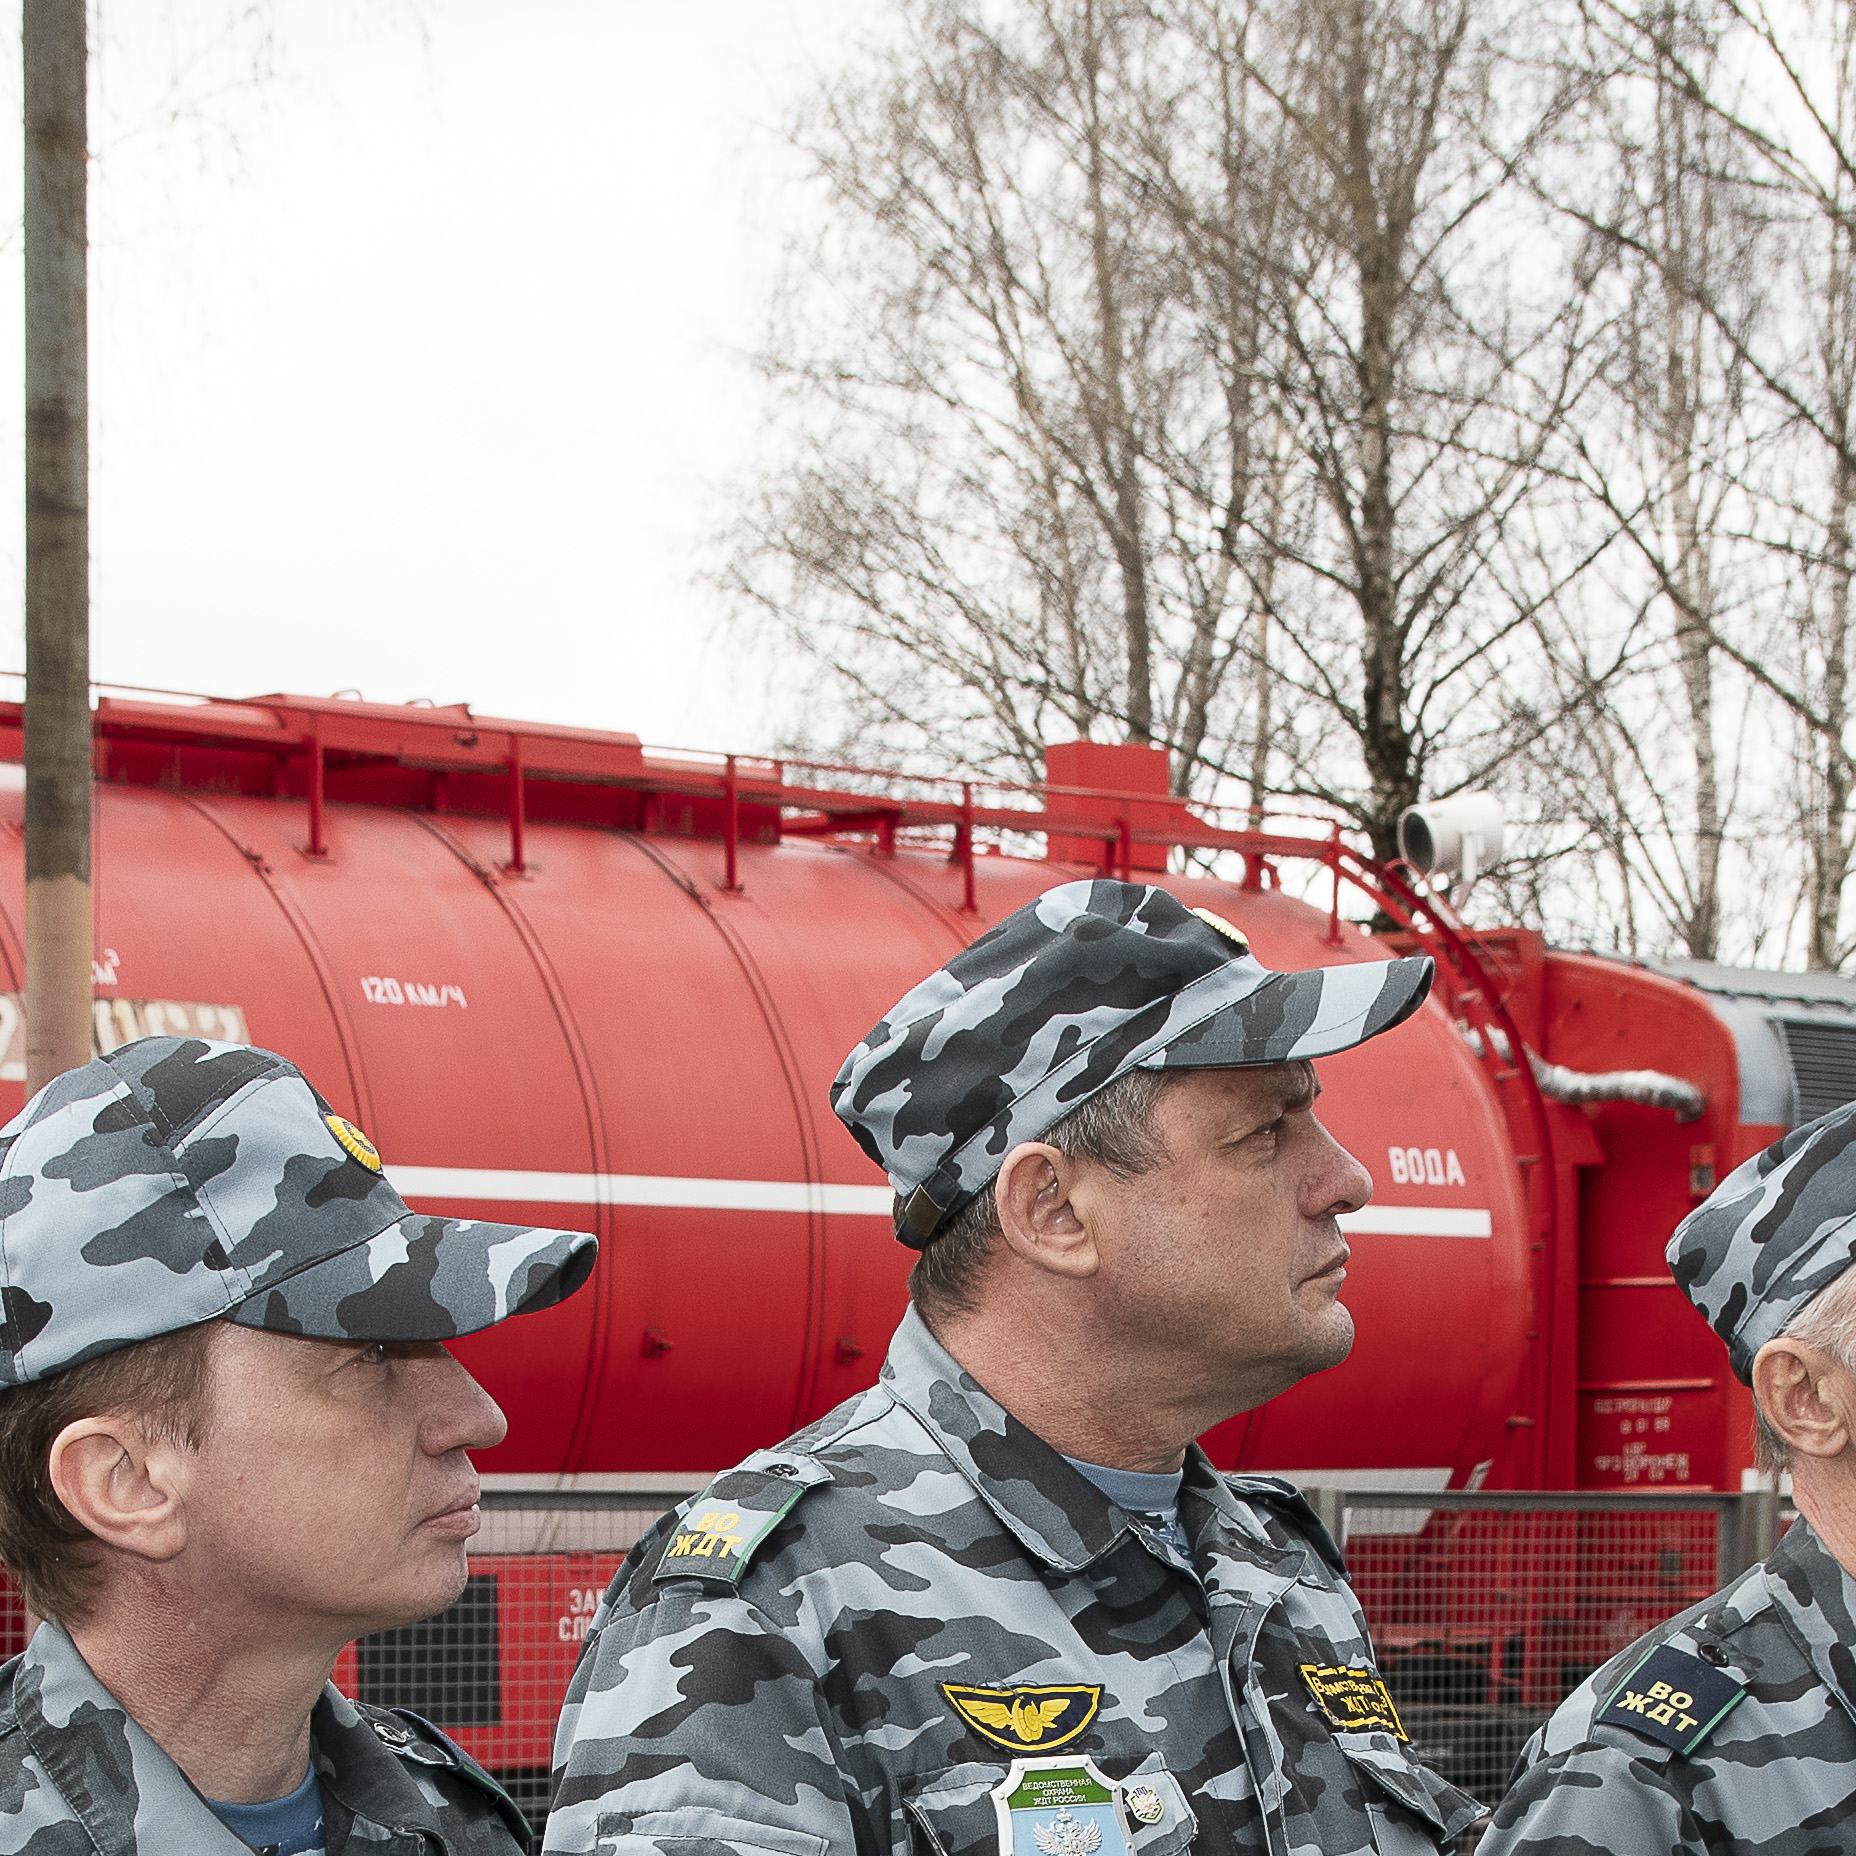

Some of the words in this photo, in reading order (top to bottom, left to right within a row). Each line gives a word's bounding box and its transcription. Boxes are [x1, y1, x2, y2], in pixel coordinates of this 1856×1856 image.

[360, 975, 405, 1006] 120
[1388, 1146, 1466, 1187] ВОДА
[695, 1511, 740, 1533] ВО
[667, 1533, 743, 1559] ЖДТ
[1646, 1680, 1694, 1710] ВО
[1615, 1690, 1699, 1733] ЖДТ
[1022, 1777, 1093, 1791] ВЕДОМСТВЕННАЯ
[1042, 1787, 1075, 1797] ОХРАНА
[1032, 1796, 1052, 1806] ЖДТ
[1052, 1794, 1087, 1805] РОССИИ
